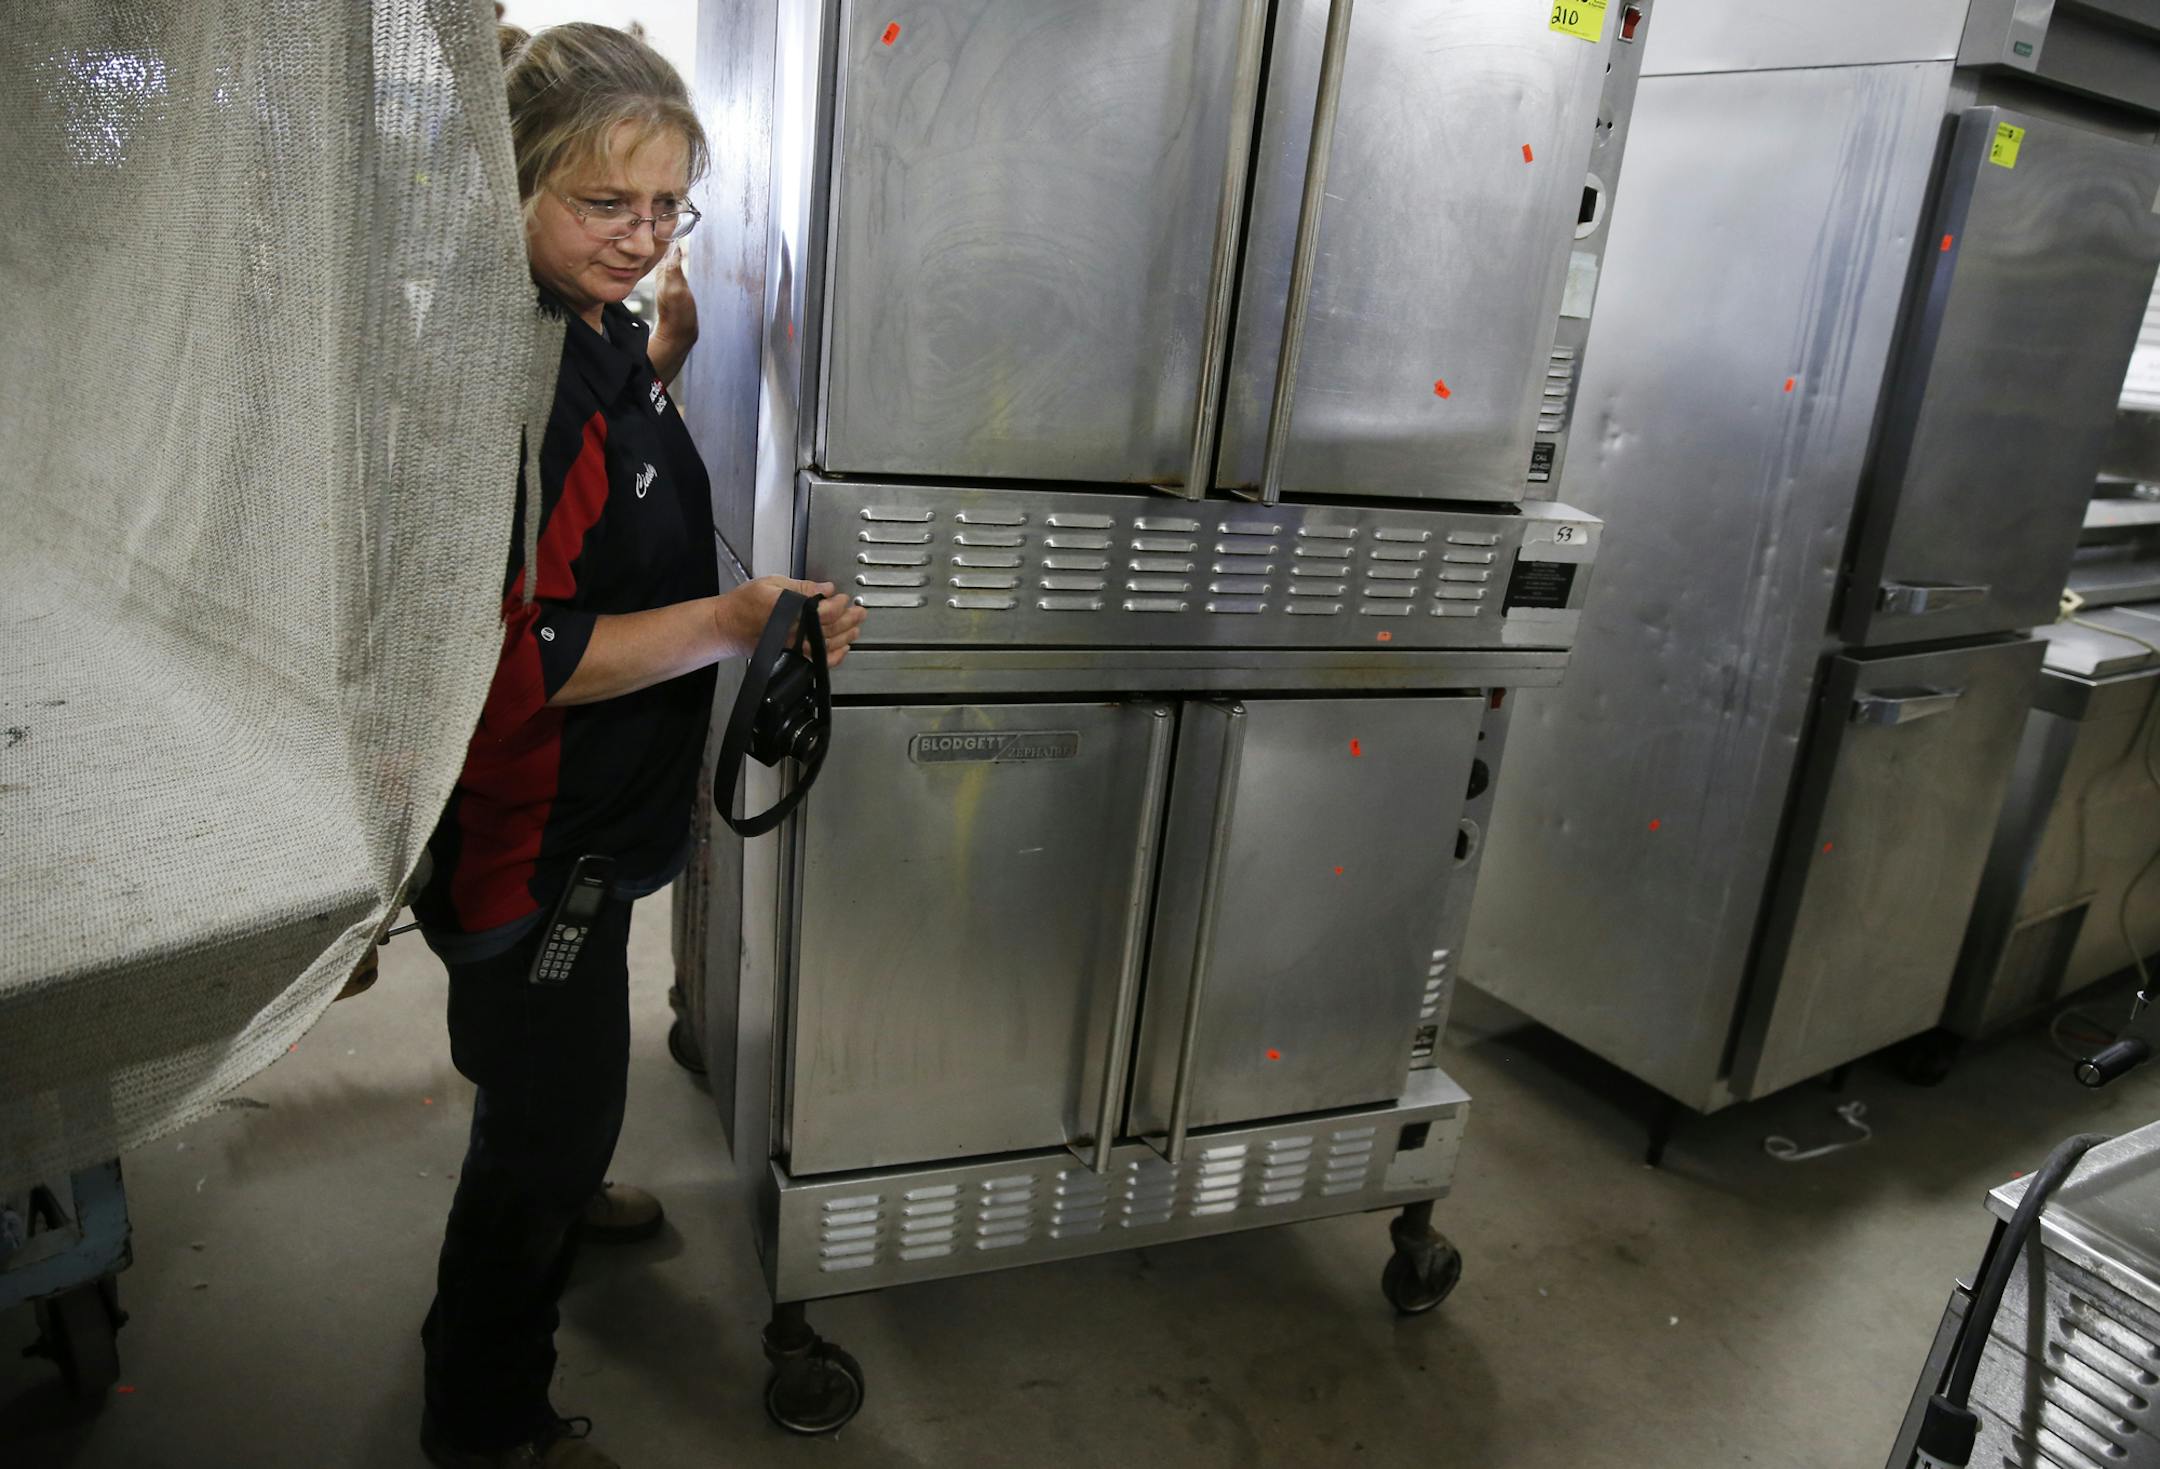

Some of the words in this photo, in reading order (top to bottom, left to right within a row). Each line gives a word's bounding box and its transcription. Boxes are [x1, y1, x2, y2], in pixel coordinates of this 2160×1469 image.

[1551, 5, 1579, 26] 210
[1555, 526, 1574, 542] 53
[920, 736, 1006, 751] BLODGETT
